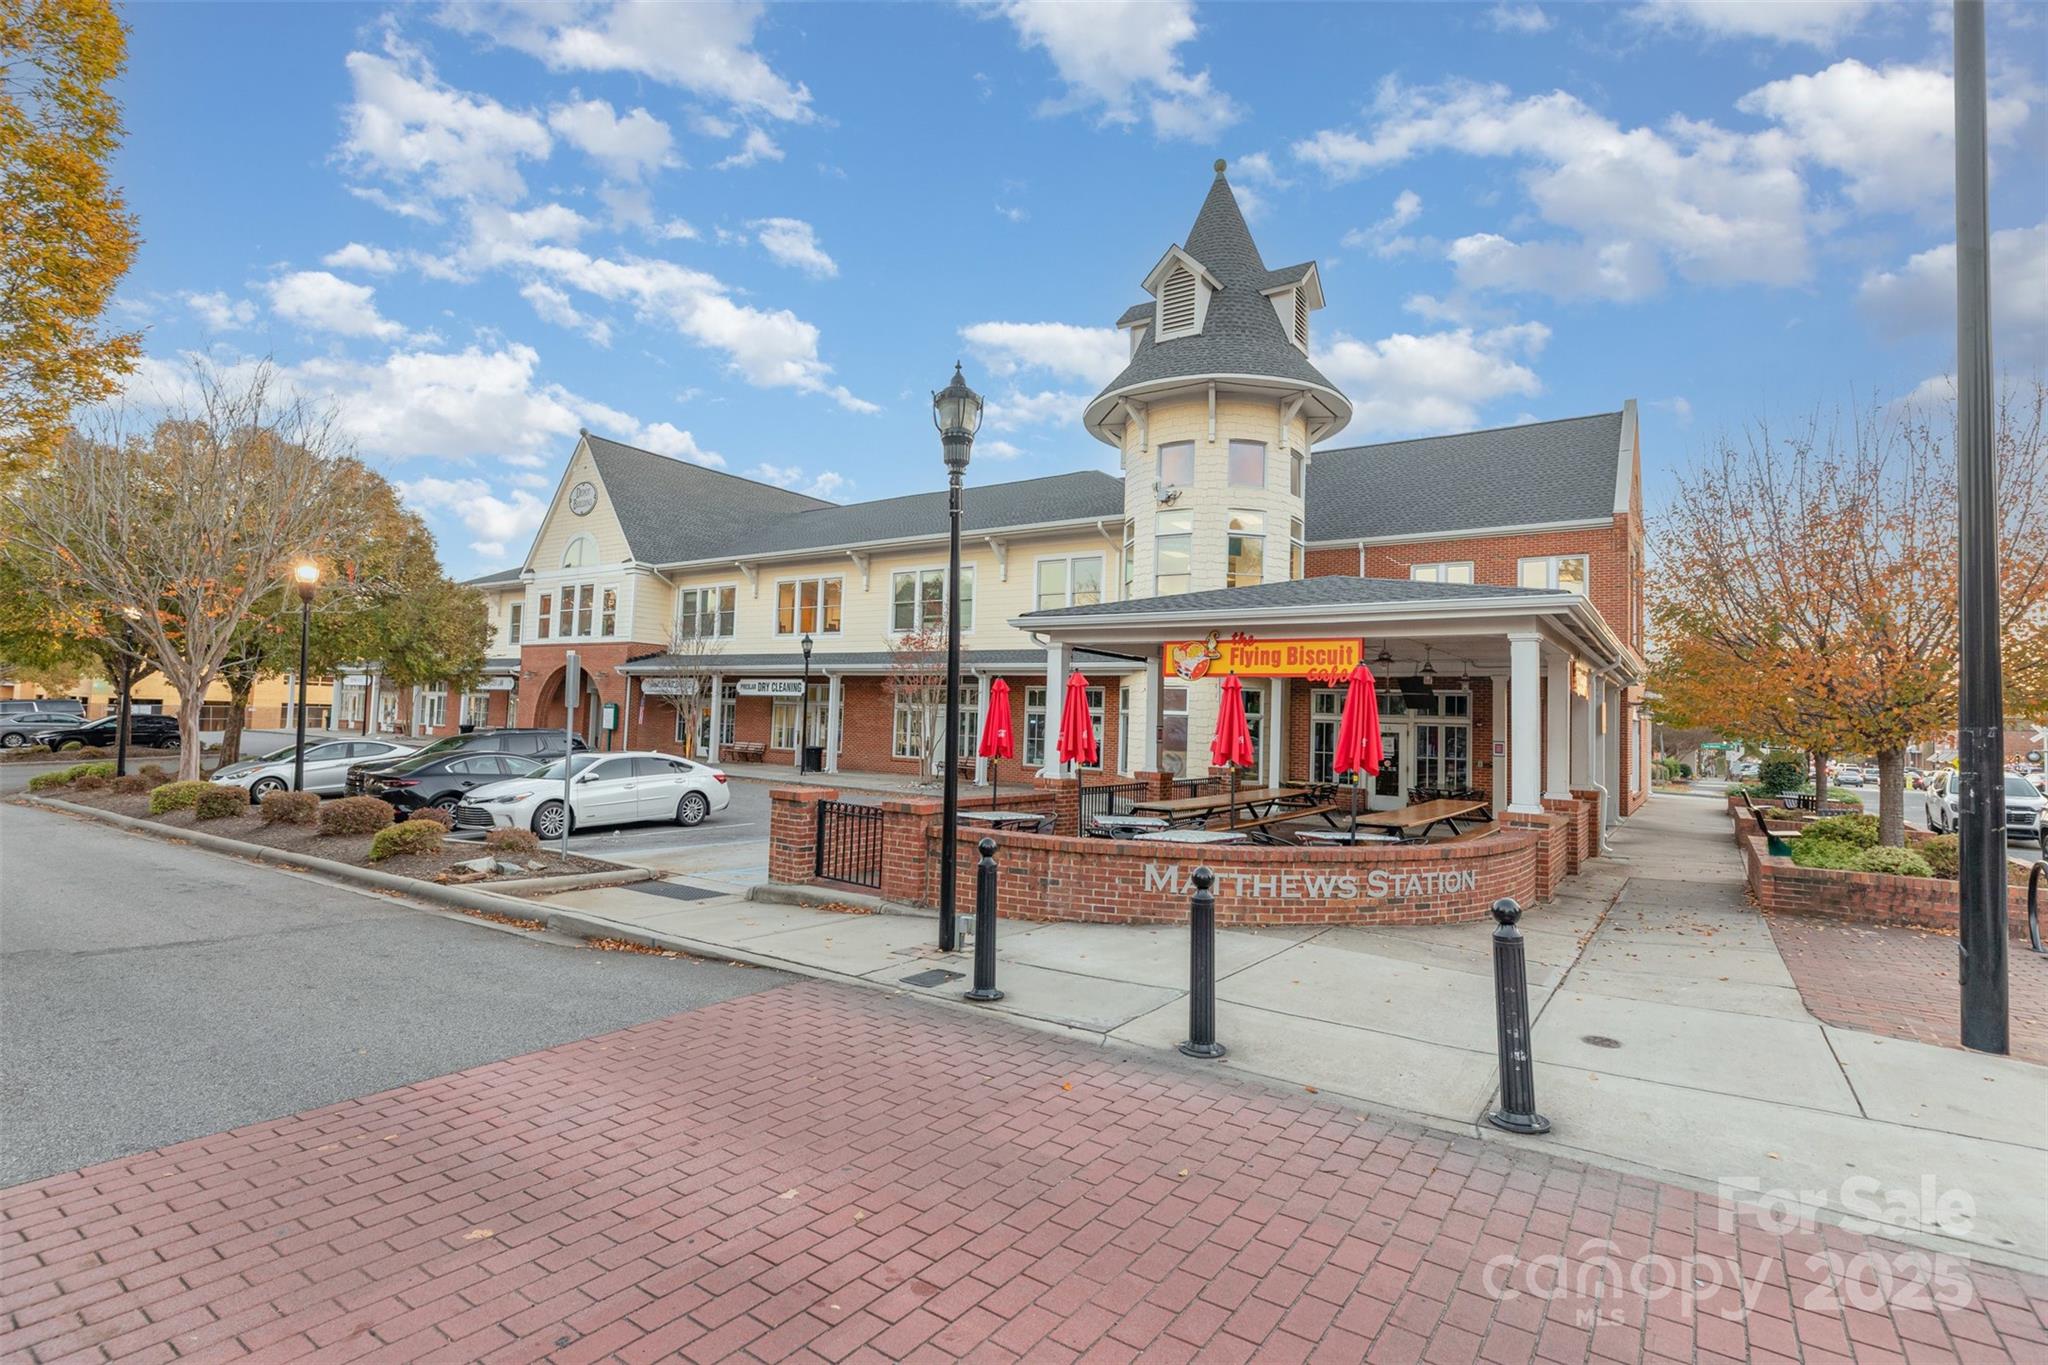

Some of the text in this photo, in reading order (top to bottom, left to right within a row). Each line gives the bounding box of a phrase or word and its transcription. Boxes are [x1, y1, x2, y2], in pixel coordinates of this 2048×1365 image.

[1231, 632, 1256, 647] the
[1230, 645, 1353, 668] Flying Biscuit
[757, 682, 771, 692] DRY
[772, 682, 802, 693] CLEANING
[1367, 869, 1477, 898] STATION
